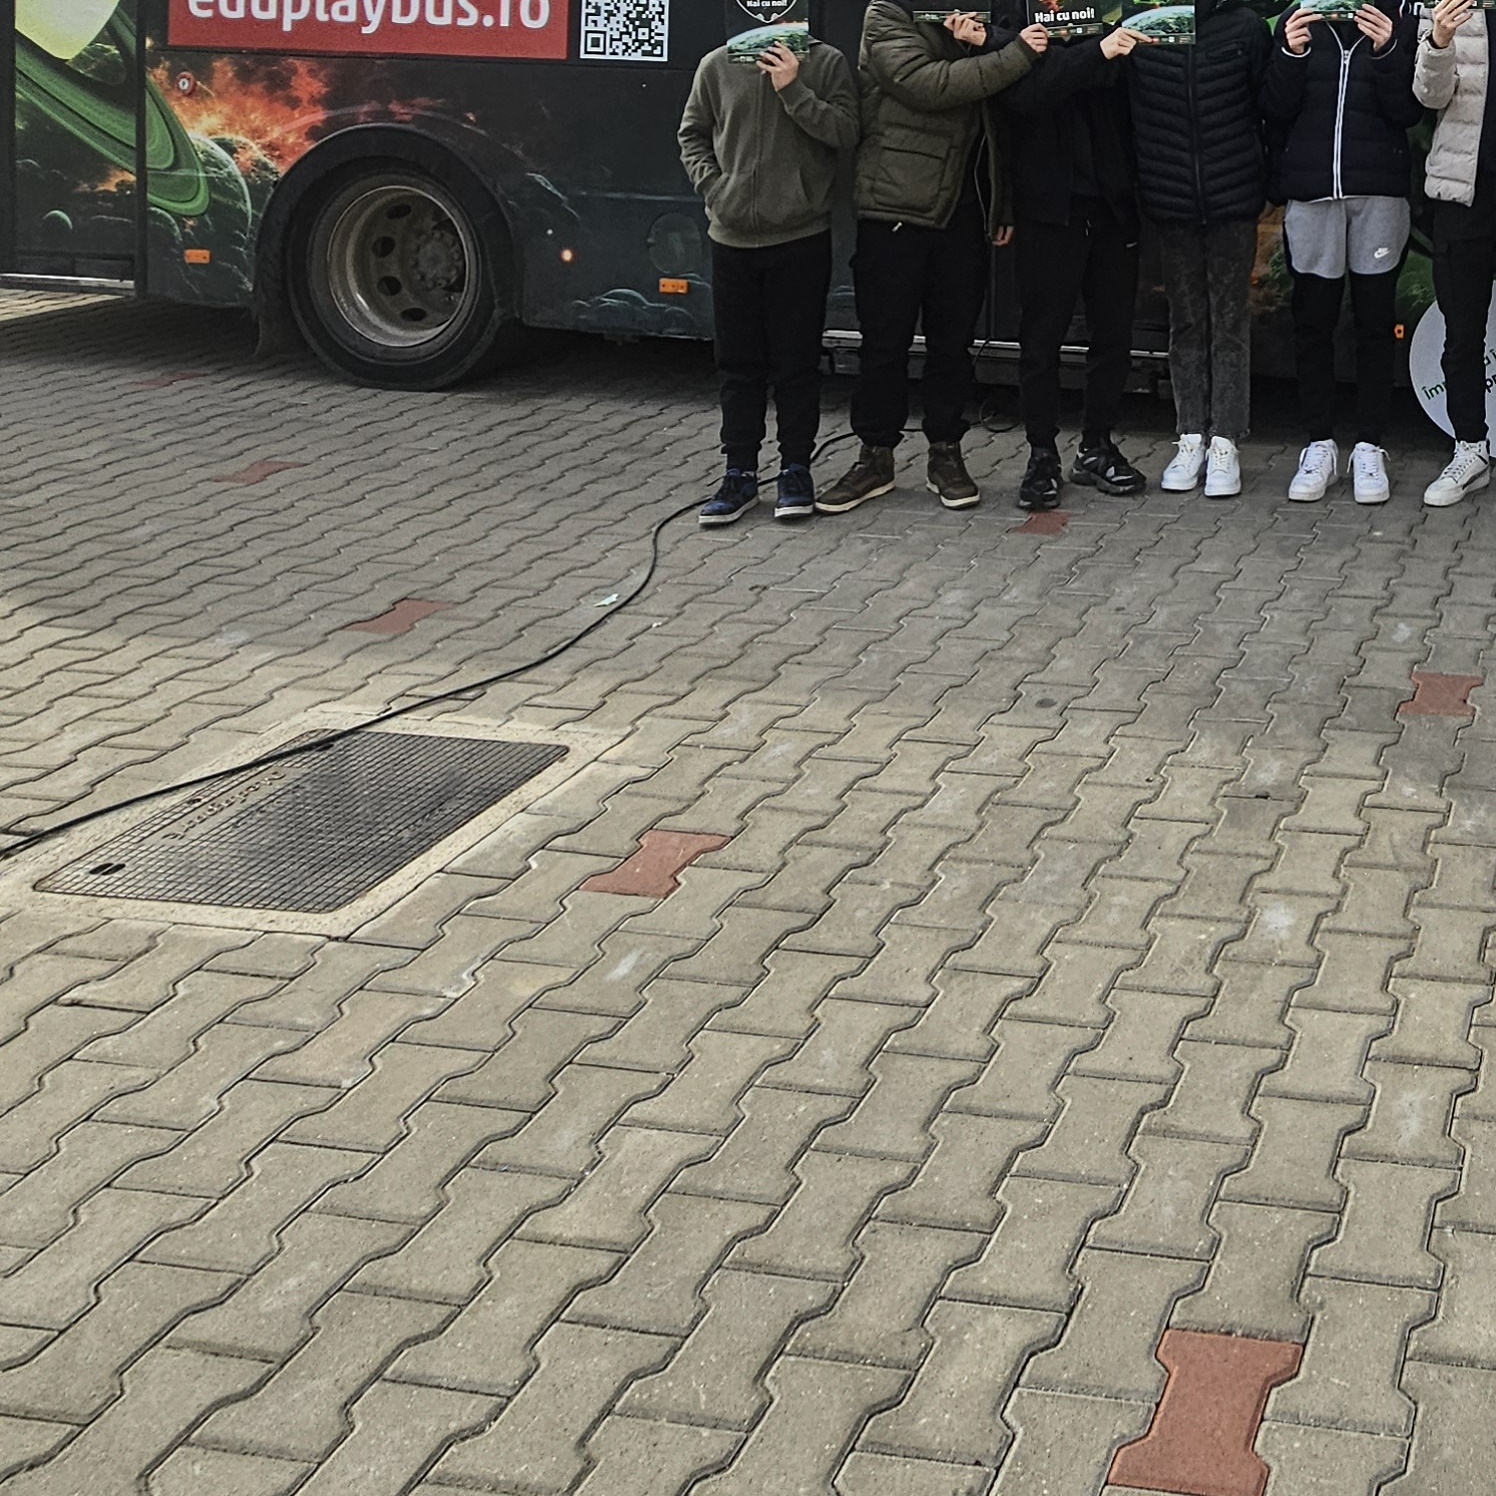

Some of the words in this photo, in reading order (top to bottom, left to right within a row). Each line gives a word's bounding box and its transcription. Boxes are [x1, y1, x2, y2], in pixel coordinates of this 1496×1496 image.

[1034, 9, 1055, 23] Hai
[1056, 11, 1070, 22] cu
[1071, 6, 1095, 20] noi!
